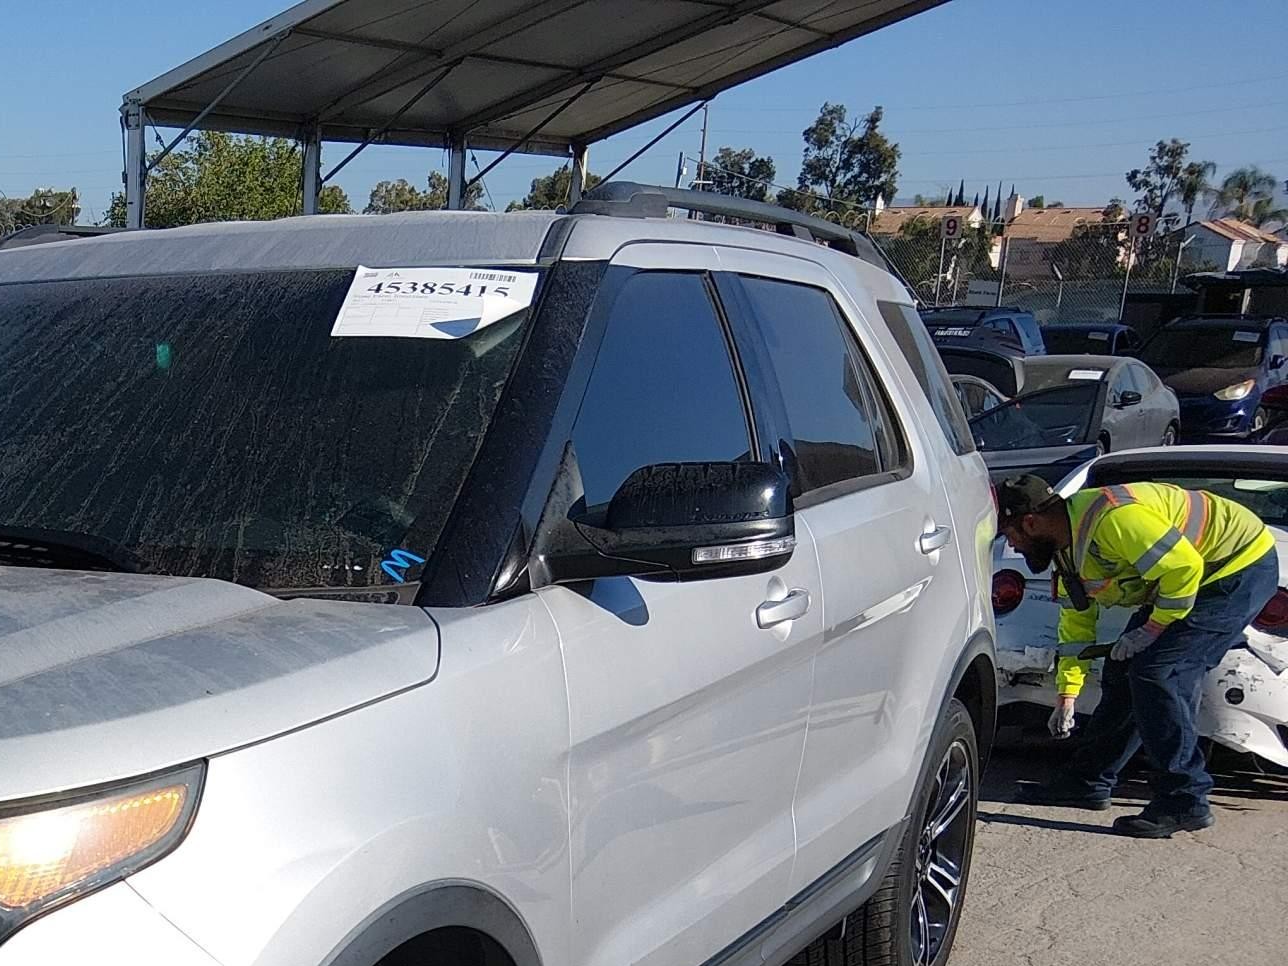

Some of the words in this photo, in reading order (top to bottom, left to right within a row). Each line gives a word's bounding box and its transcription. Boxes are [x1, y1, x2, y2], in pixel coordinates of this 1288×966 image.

[944, 219, 958, 236] 9
[1135, 217, 1150, 236] 8
[367, 282, 509, 297] 45385415
